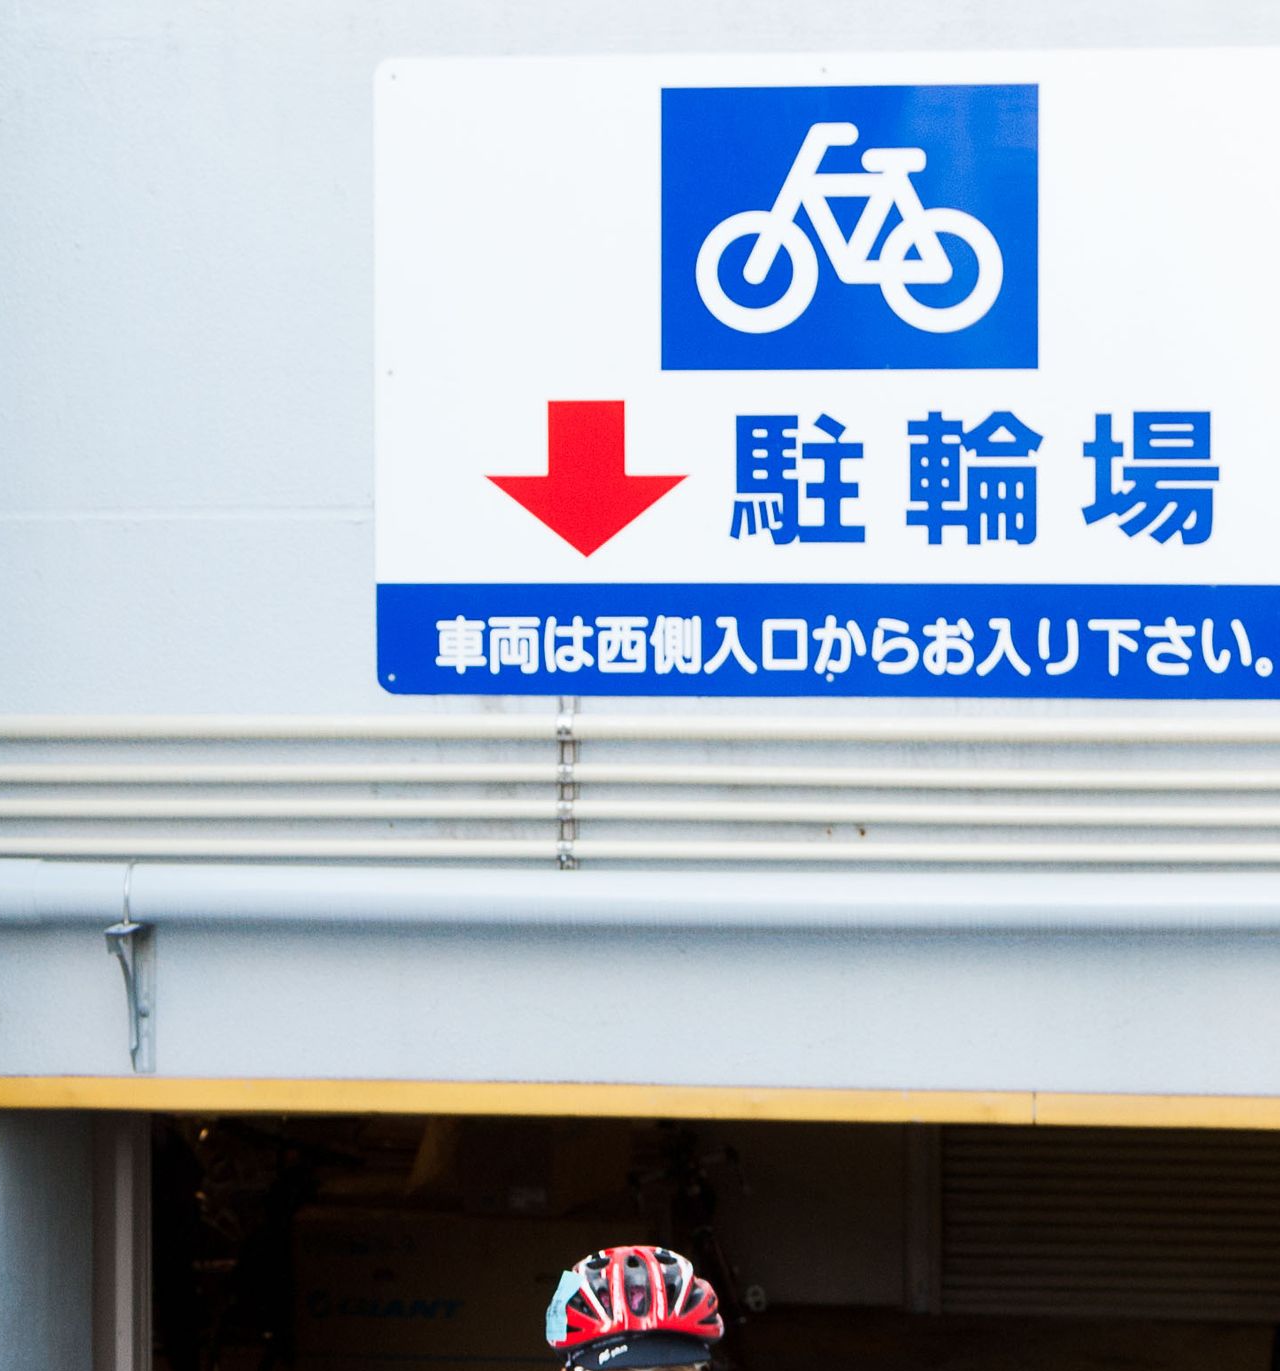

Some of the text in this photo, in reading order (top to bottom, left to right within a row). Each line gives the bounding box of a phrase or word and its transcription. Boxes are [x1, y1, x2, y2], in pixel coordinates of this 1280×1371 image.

[728, 410, 1221, 546] 駐輪場
[435, 614, 1274, 677] 車両は西側入口からお入り下さい。
